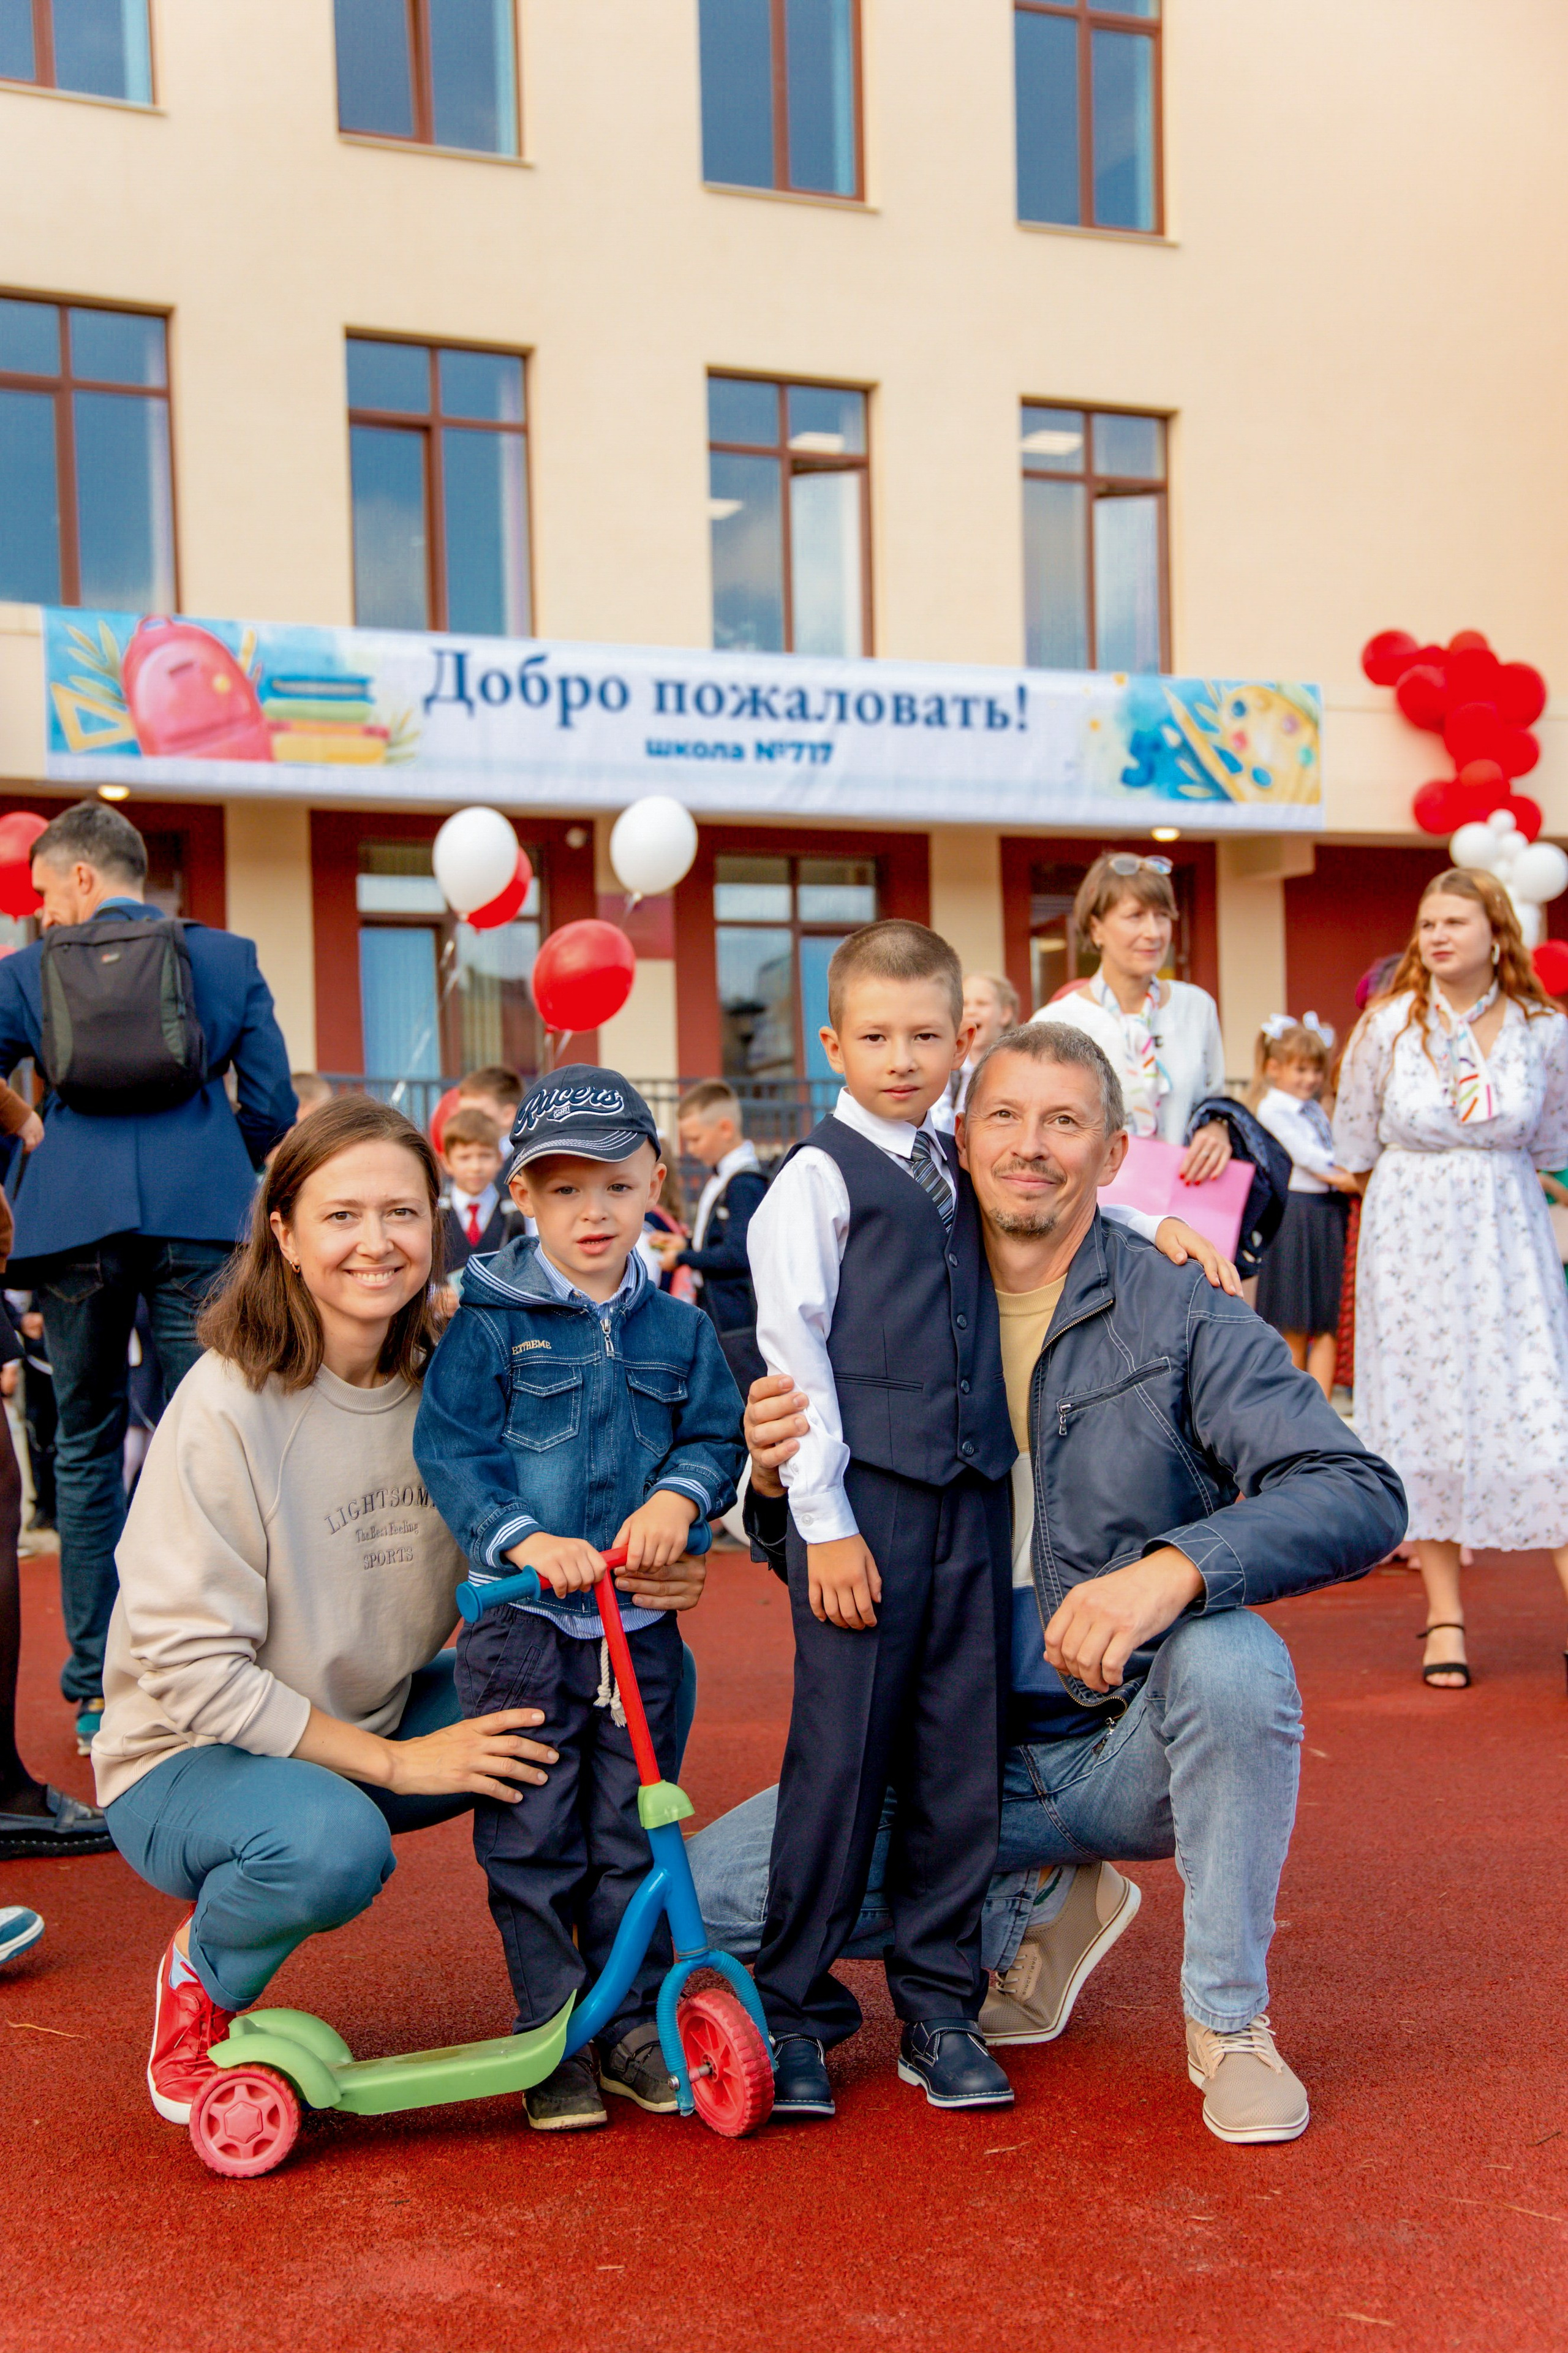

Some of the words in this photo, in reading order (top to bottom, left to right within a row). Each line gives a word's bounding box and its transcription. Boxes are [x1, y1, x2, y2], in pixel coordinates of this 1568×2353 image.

[423, 649, 630, 730] Добро
[654, 679, 1027, 732] пожаловать!
[646, 738, 745, 761] школа
[514, 1086, 623, 1136] Racers
[324, 1486, 437, 1535] LIGHTSOM
[389, 1520, 420, 1535] Feeling
[363, 1546, 414, 1570] SPORTS
